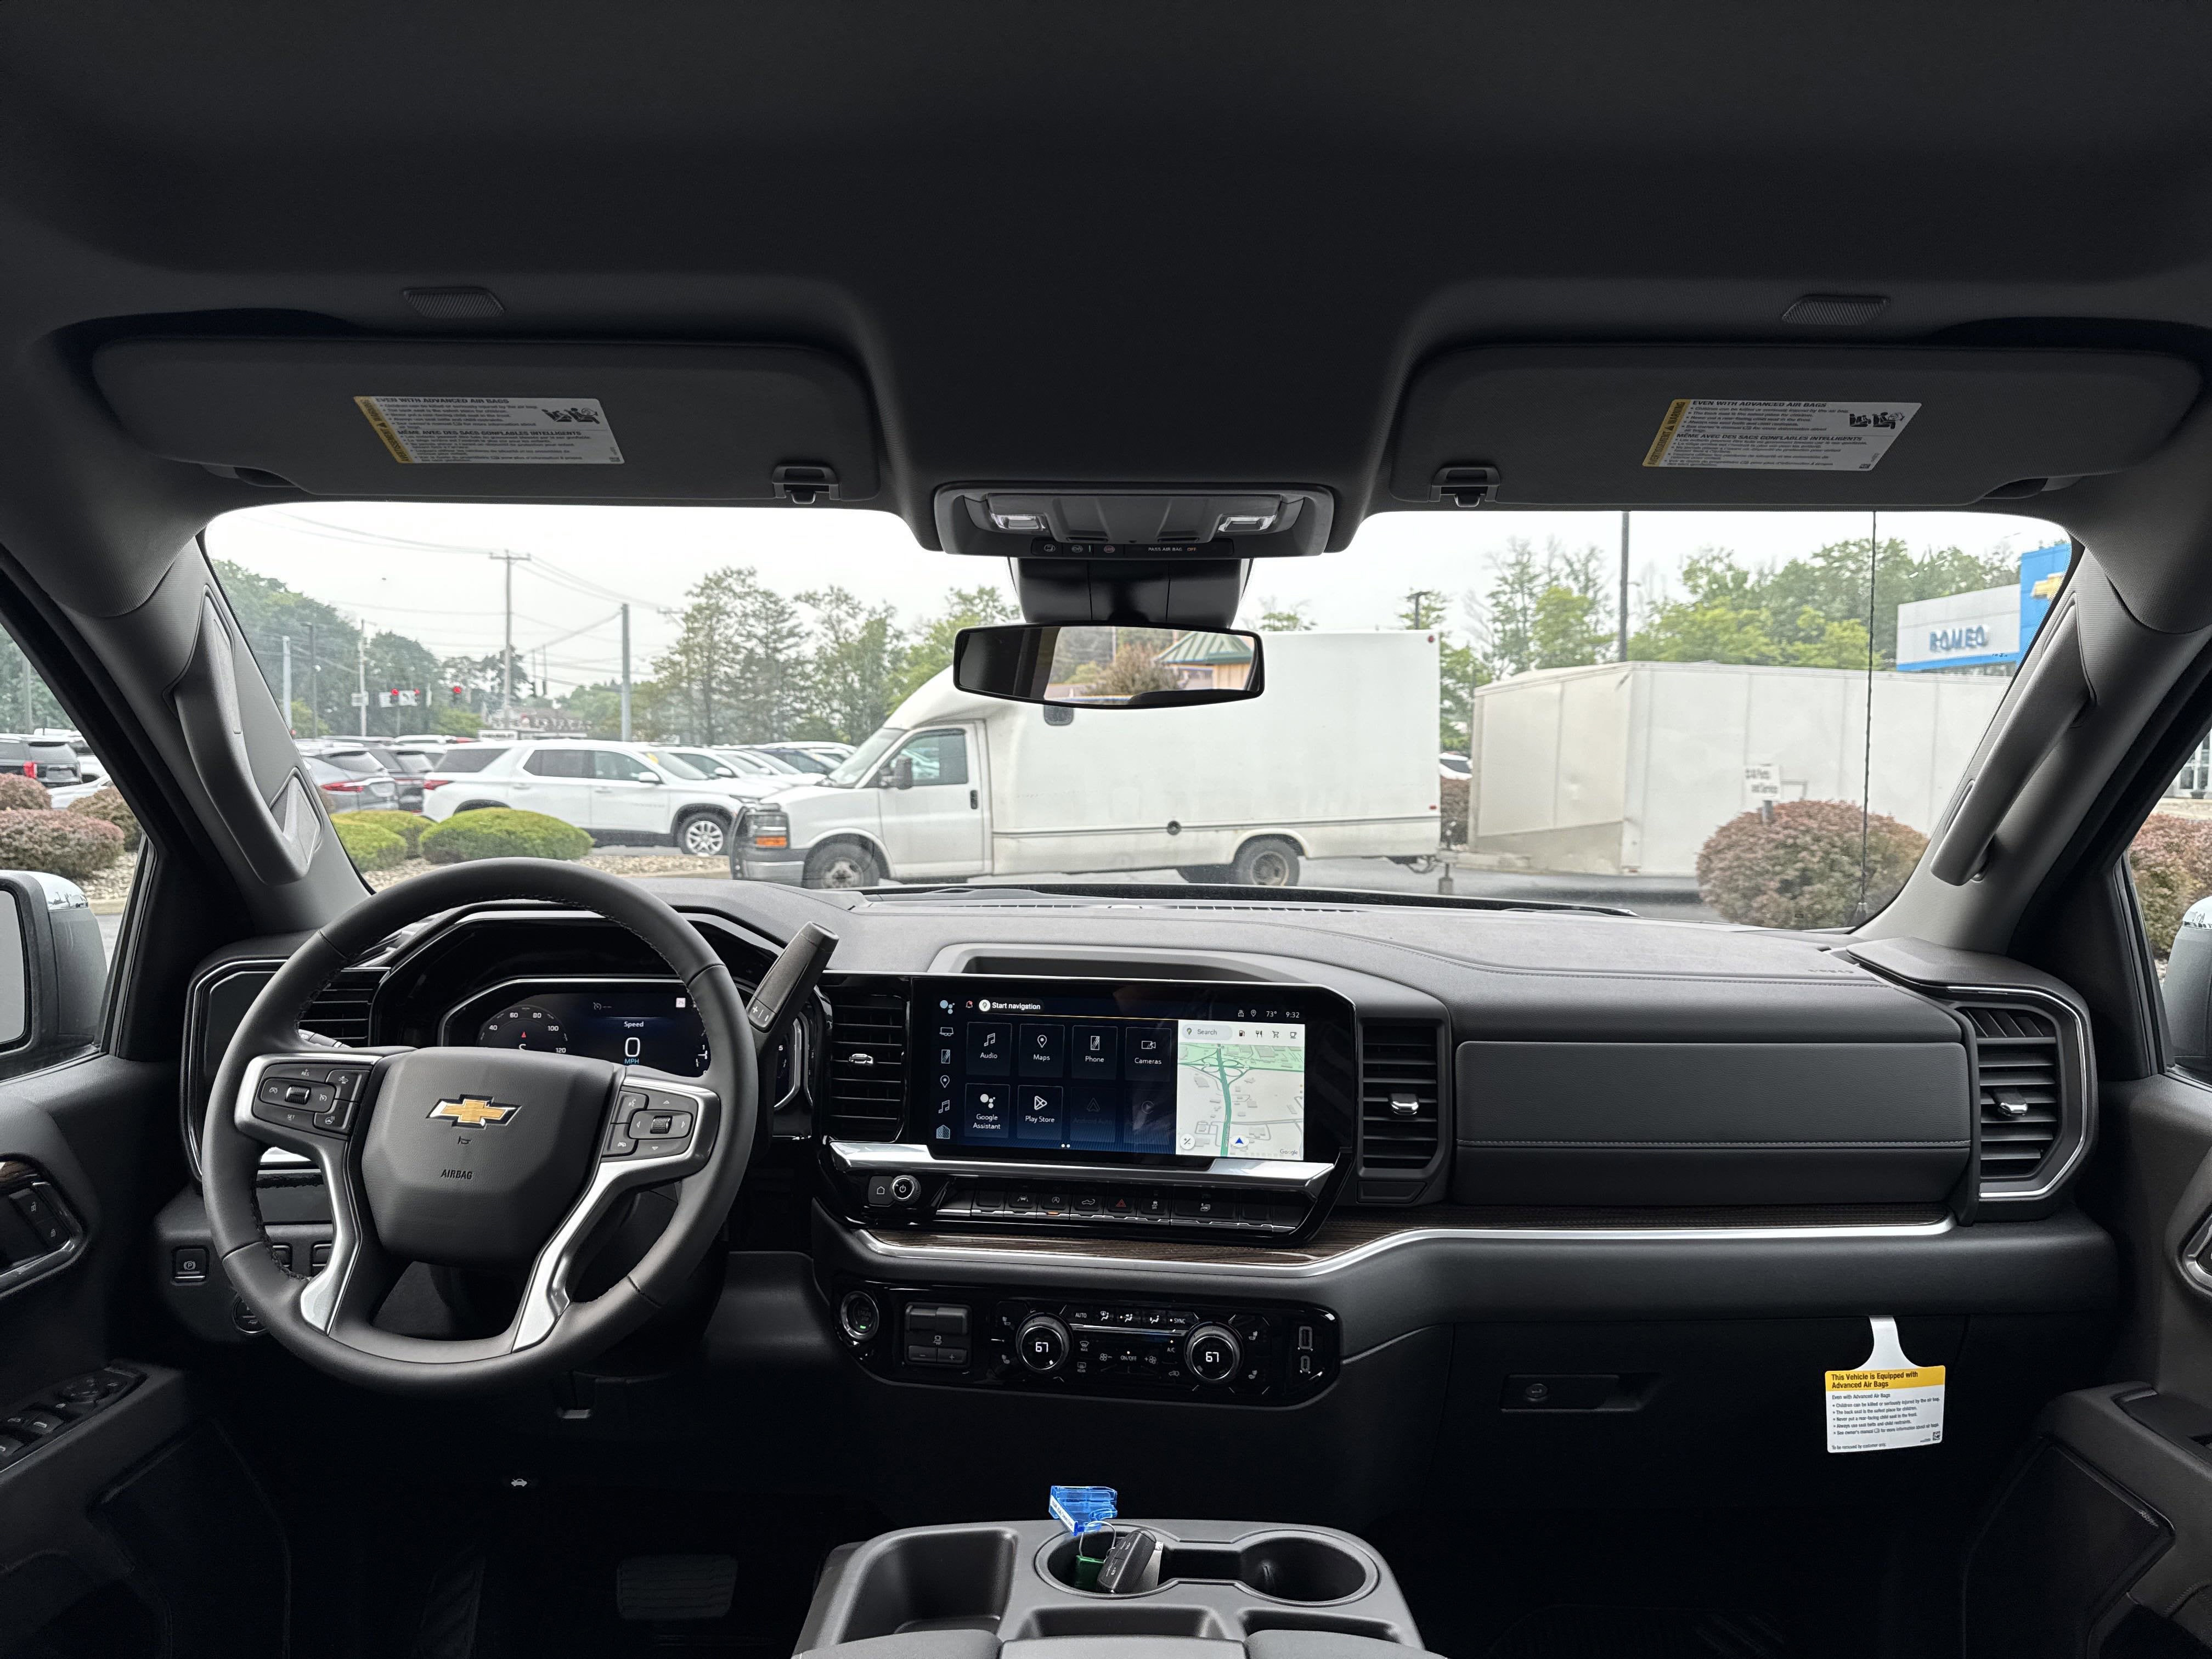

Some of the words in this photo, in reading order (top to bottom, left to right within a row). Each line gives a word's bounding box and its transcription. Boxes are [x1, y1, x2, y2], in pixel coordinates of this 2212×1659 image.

[625, 1037, 640, 1057] 0
[1025, 1115, 1037, 1124] Play
[441, 1169, 473, 1180] AIRBAG
[1877, 1372, 1904, 1380] Equipped
